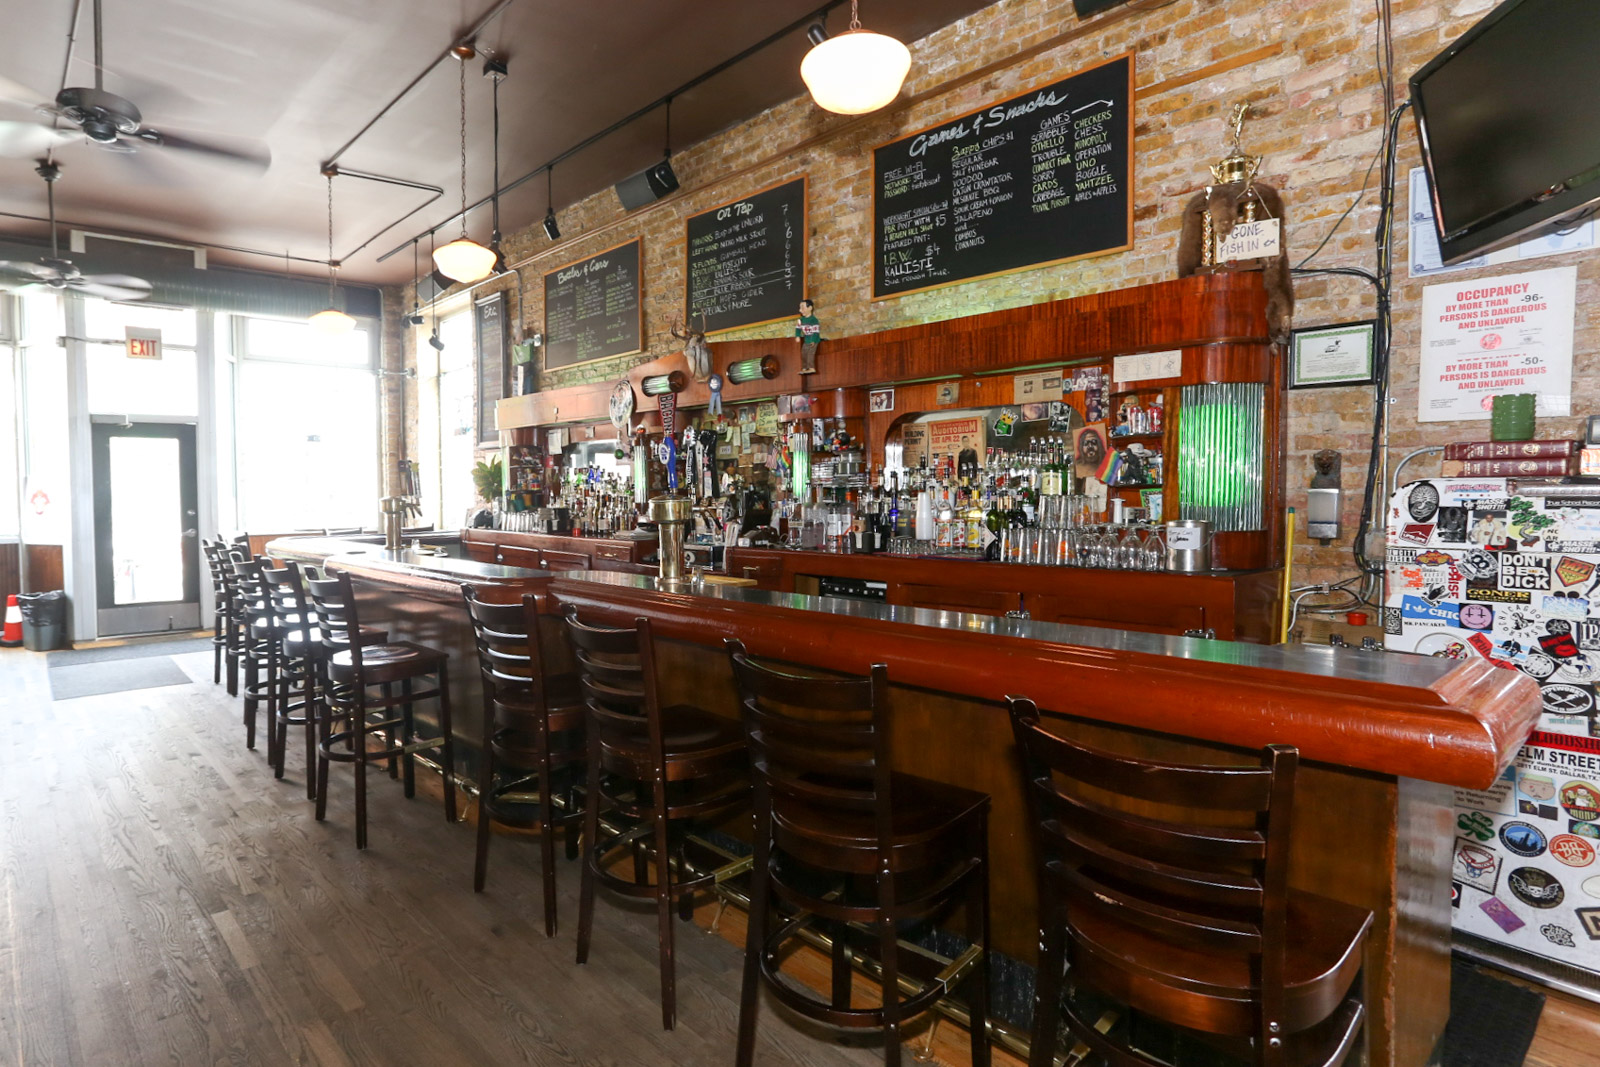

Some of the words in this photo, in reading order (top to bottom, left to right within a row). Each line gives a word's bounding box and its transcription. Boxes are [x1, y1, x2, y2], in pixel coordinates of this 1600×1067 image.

[909, 123, 970, 157] Games
[984, 91, 1069, 128] Snacks
[1040, 111, 1071, 129] GAMES
[1074, 110, 1112, 129] CHECKERS
[1031, 125, 1069, 144] SCRABBLE
[1074, 123, 1103, 140] CHESS
[982, 134, 1005, 148] CHIPS
[1031, 136, 1065, 153] OTHELLO
[1074, 131, 1108, 150] MONOPOLY
[1032, 146, 1067, 163] TROUBLE
[1074, 142, 1112, 161] OPERATION
[952, 154, 983, 169] REGULAR
[971, 157, 999, 173] VINEGAR
[1032, 158, 1056, 174] CONNECT
[1076, 158, 1096, 171] UNO
[884, 168, 903, 181] FREE
[953, 172, 983, 188] VOODOO
[1032, 169, 1056, 184] SORRY
[1075, 164, 1108, 182] BOGGLE
[952, 184, 972, 197] CAJUN
[1032, 178, 1059, 194] CARDS
[1075, 174, 1114, 191] YAHTZEE
[983, 186, 1000, 197] BBQ
[1032, 186, 1066, 203] CRIBBAGE
[781, 204, 789, 216] 7
[884, 224, 896, 234] PBR
[914, 215, 931, 226] WITH
[935, 214, 947, 227] $5
[1231, 222, 1264, 240] GONE
[749, 239, 768, 250] HEAD
[786, 226, 793, 239] 6
[785, 240, 791, 250] 6
[784, 250, 791, 259] 6
[784, 260, 791, 268] 6
[884, 257, 934, 277] KALLISTI
[784, 268, 792, 278] 3
[785, 280, 793, 291] 7
[1456, 282, 1530, 302] OCCUPANCY
[731, 299, 752, 311] MORE
[1439, 311, 1479, 323] PERSONS
[1480, 309, 1489, 318] IS
[1491, 302, 1547, 317] DANGEROUS
[1445, 304, 1456, 313] BY
[1458, 301, 1483, 311] MORE
[1485, 298, 1509, 308] THAN
[1458, 320, 1476, 330] AND
[1478, 315, 1526, 328] UNLAWFUL
[130, 338, 157, 356] EXIT
[1445, 364, 1456, 373] BY
[1458, 361, 1483, 371] MORE
[1485, 359, 1509, 369] THAN
[1439, 372, 1479, 383] PERSONS
[1480, 371, 1489, 380] IS
[1491, 366, 1547, 378] DANGEROUS
[1458, 381, 1476, 390] AND
[1478, 377, 1526, 388] UNLAWFUL
[1502, 554, 1552, 567] DON'T
[1502, 566, 1528, 576] BE
[1536, 567, 1549, 577] A
[1502, 575, 1550, 589] DICK
[1467, 588, 1530, 598] GONER
[1404, 603, 1411, 611] I
[1582, 623, 1600, 640] IP
[1517, 745, 1545, 761] ELM
